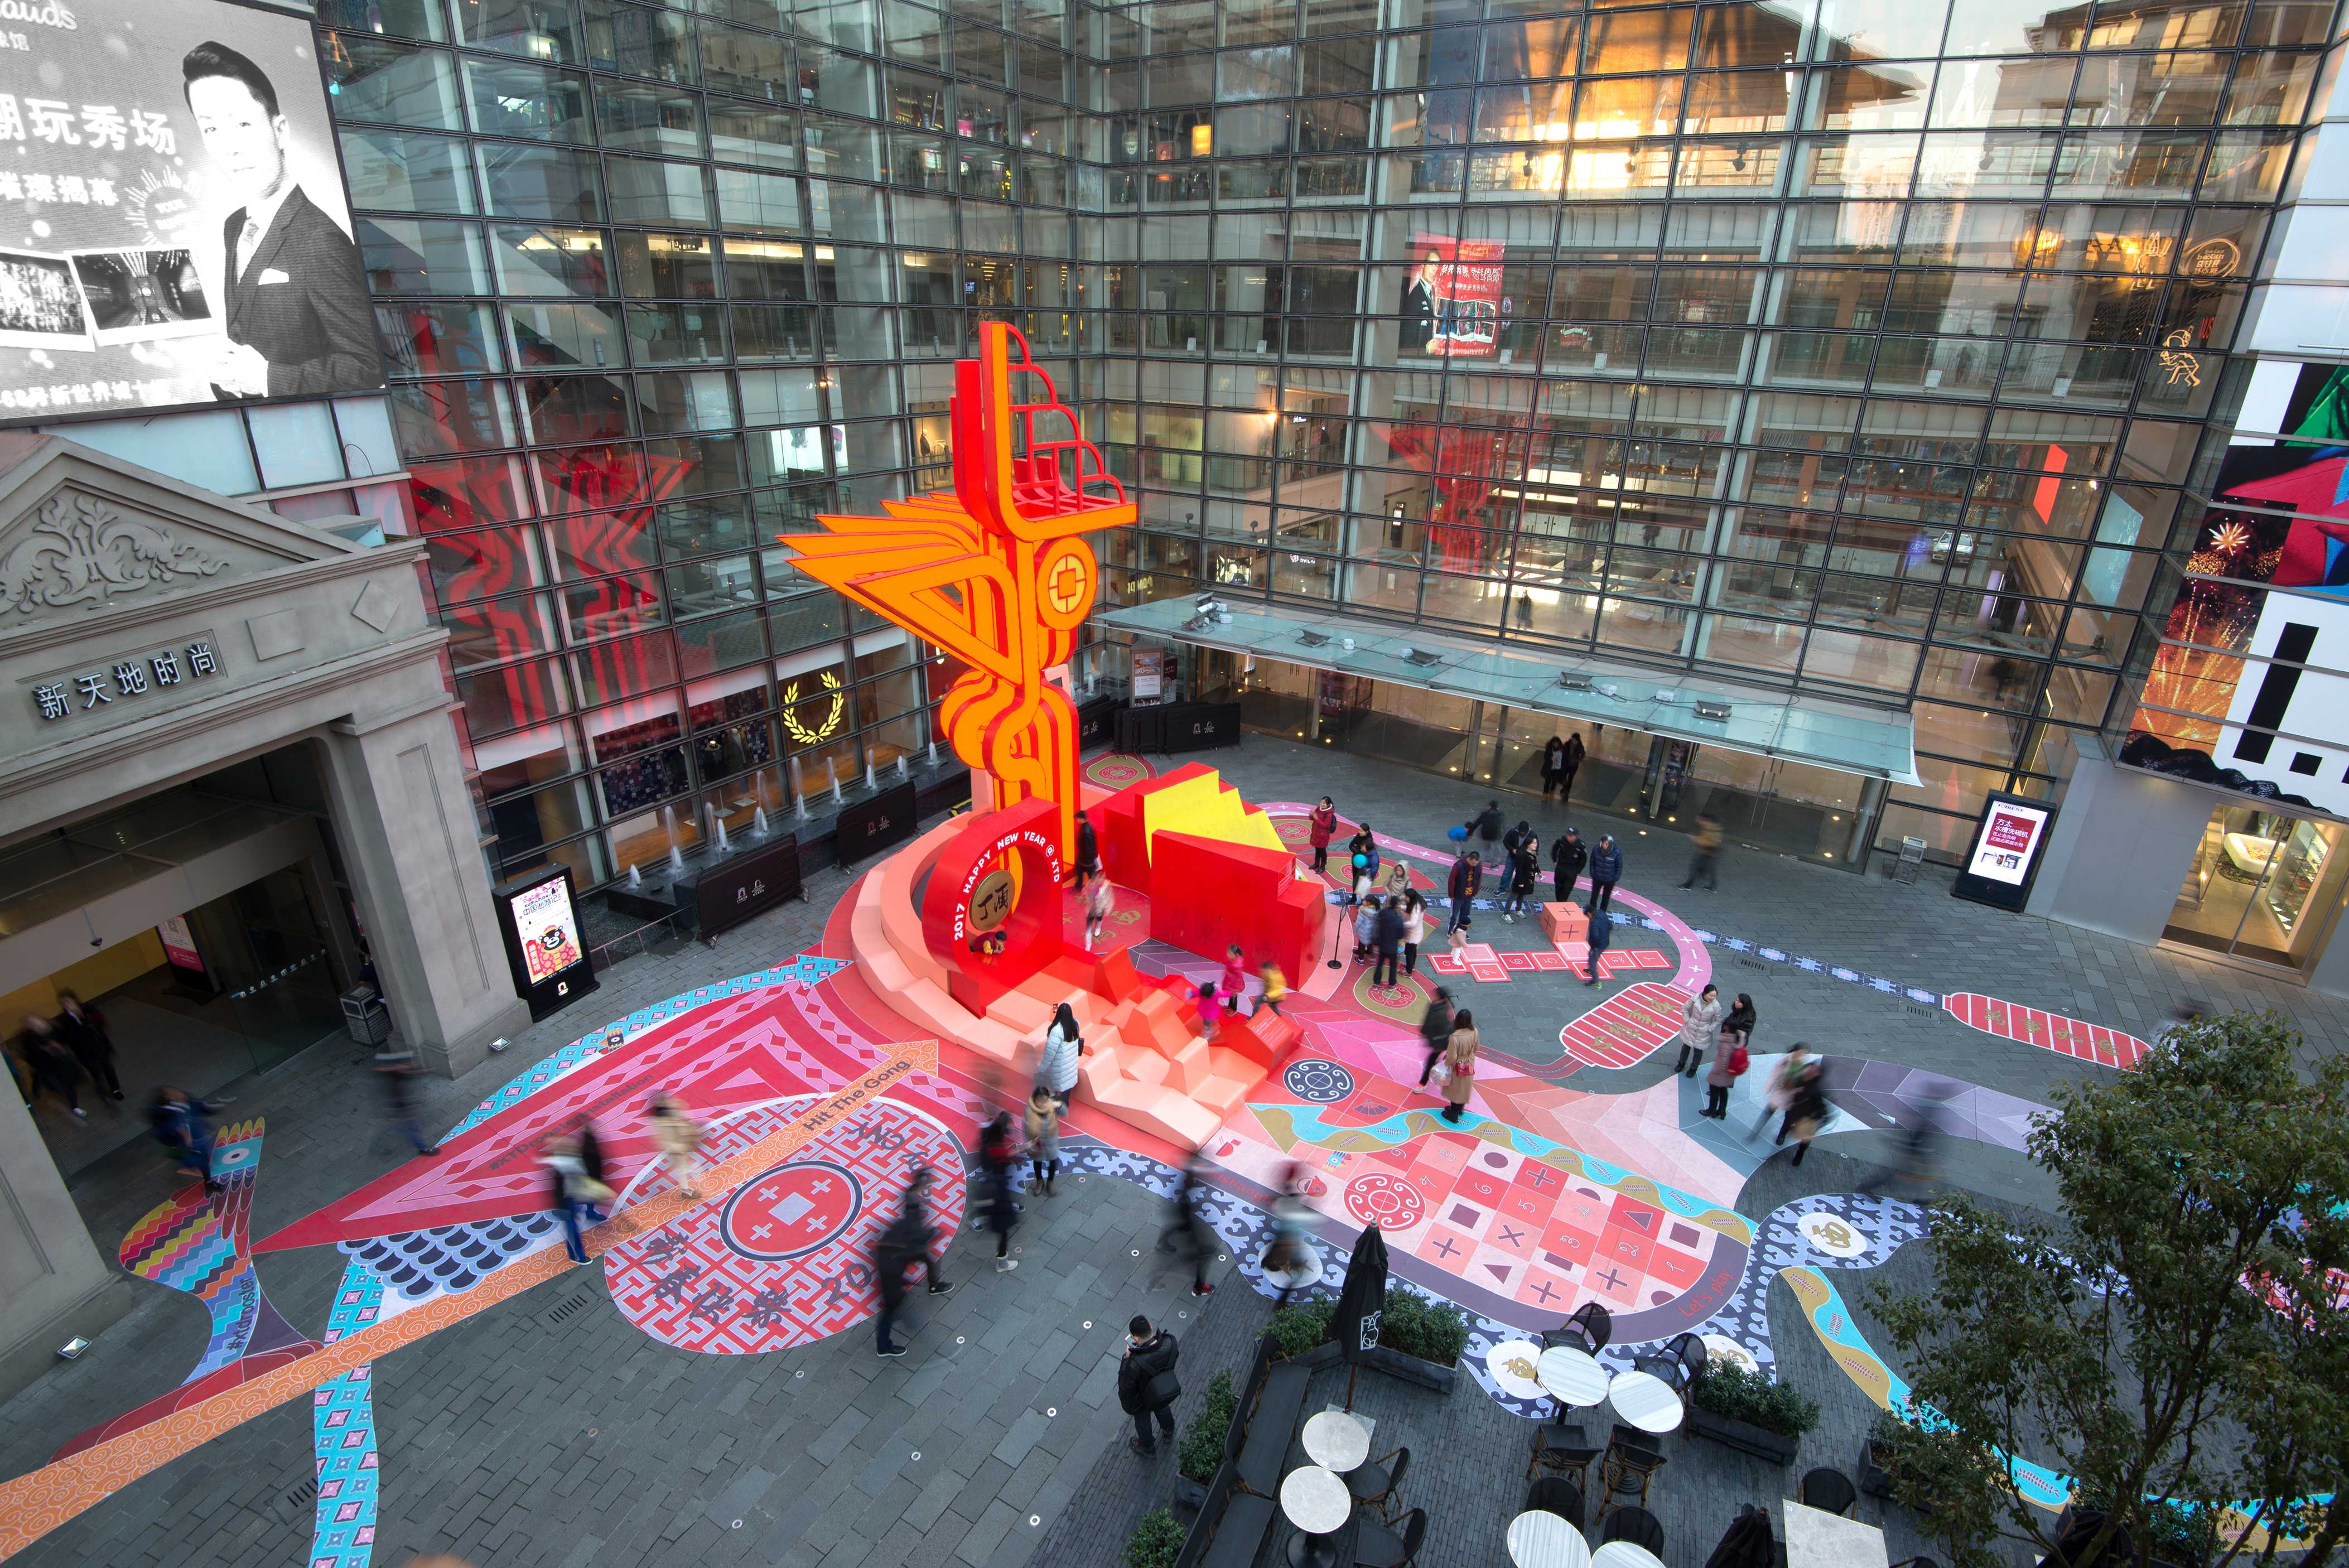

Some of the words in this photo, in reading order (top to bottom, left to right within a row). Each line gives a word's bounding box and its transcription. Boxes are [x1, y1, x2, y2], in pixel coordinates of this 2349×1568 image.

[32, 643, 217, 720] 新天地时尚
[1994, 825, 2028, 838] 水槽洗碗机
[1996, 818, 2013, 828] 方太
[524, 894, 549, 908] KUMAMON
[954, 903, 965, 941] 2017
[963, 850, 991, 894] HAPPY
[997, 832, 1019, 850] NEW
[1024, 831, 1046, 847] YEAR
[1051, 858, 1060, 883] XTD
[803, 1111, 834, 1131] Hit
[828, 1088, 865, 1111] The
[864, 1060, 911, 1089] Gong
[847, 1121, 905, 1150] CNY
[1677, 1292, 1714, 1318] Let's
[1710, 1268, 1734, 1295] play
